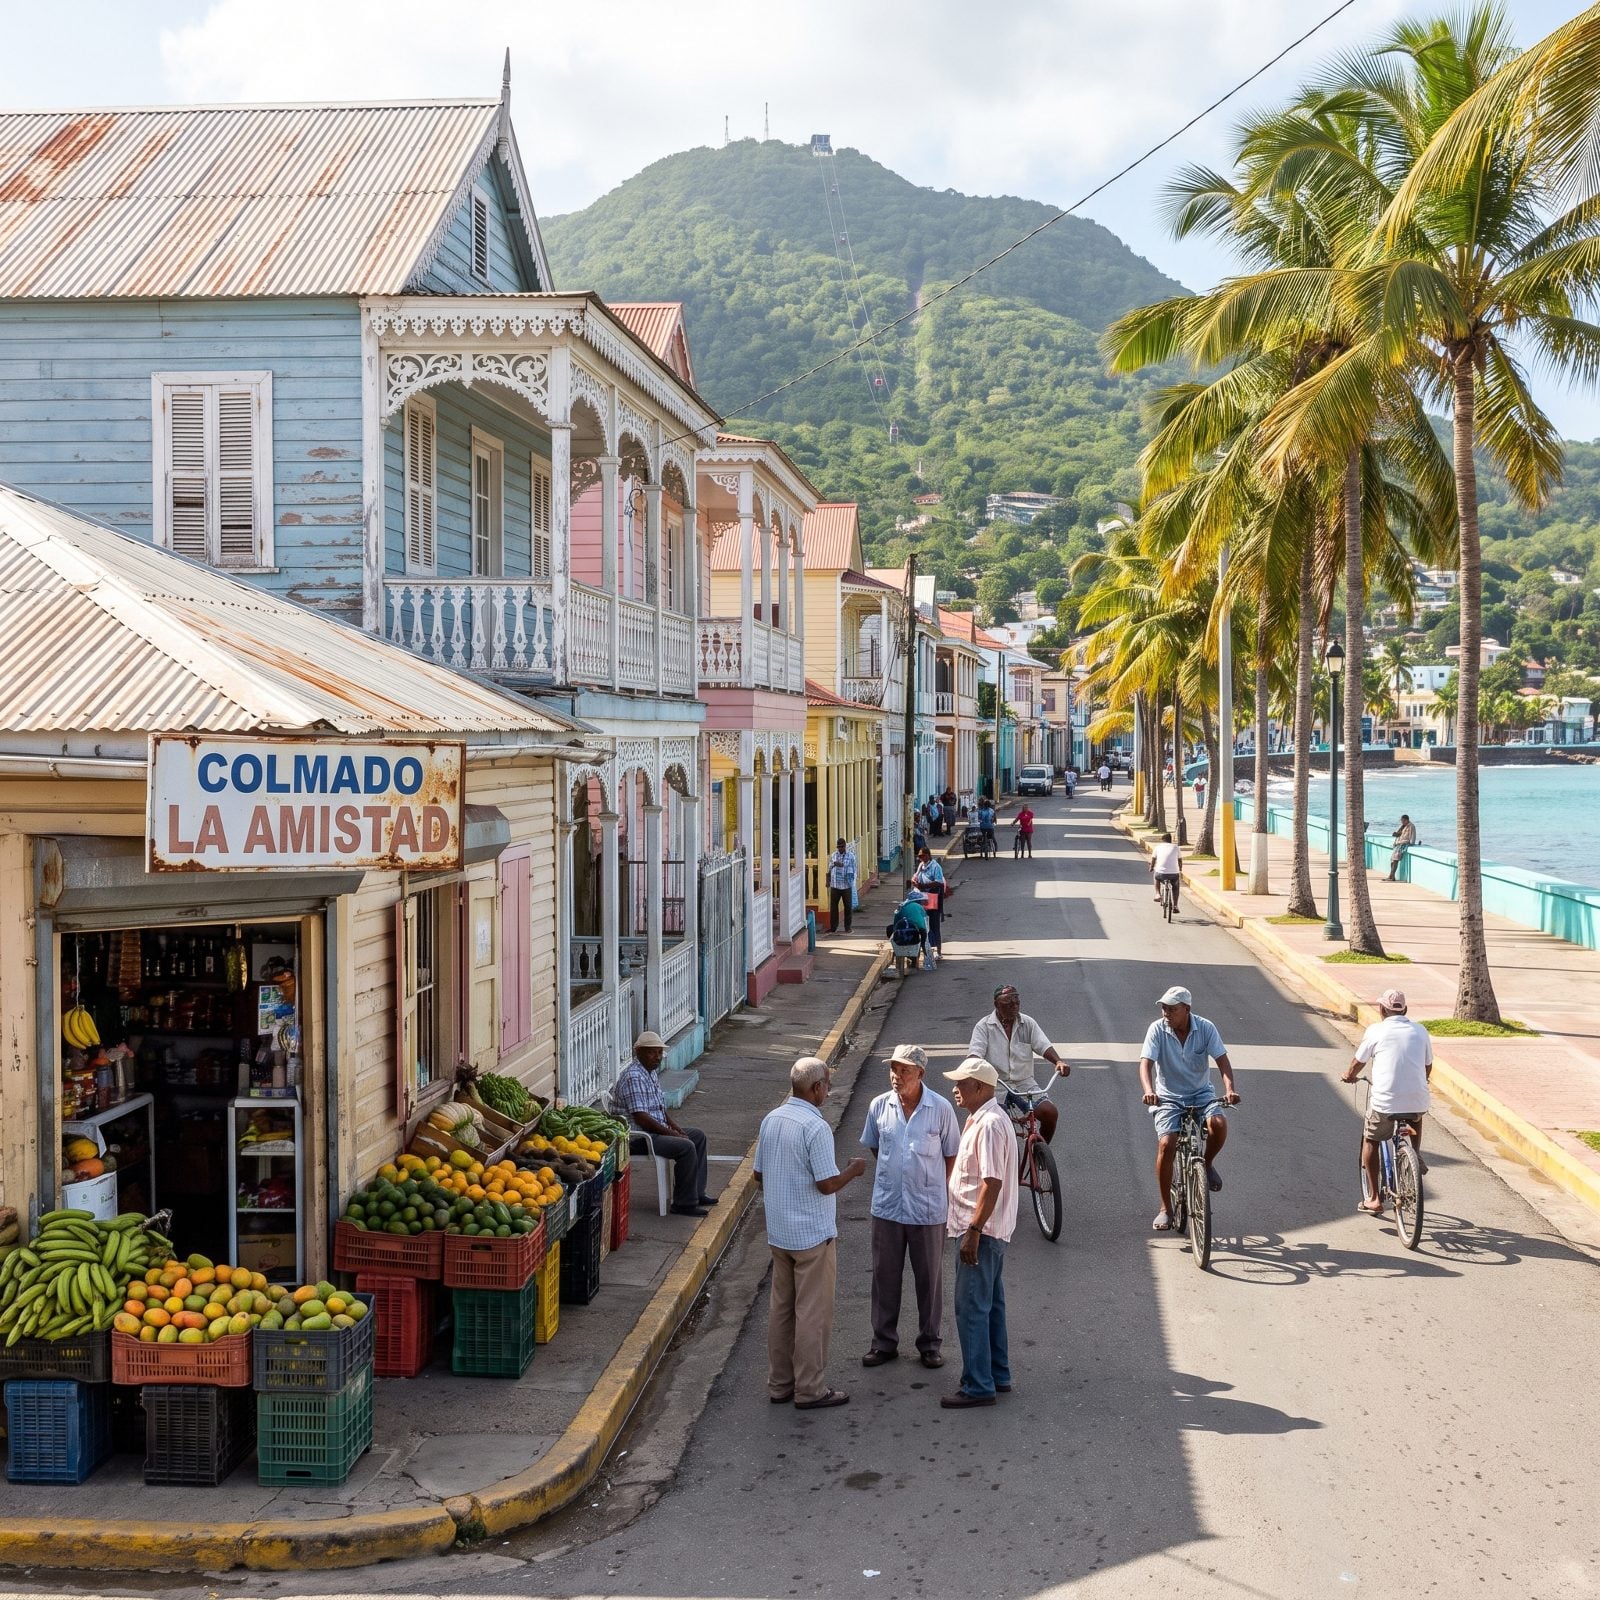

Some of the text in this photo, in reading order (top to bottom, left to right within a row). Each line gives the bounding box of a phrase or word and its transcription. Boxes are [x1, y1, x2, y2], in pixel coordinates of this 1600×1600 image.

[198, 753, 422, 794] COLMADO
[168, 805, 450, 853] LA AMISTAD
